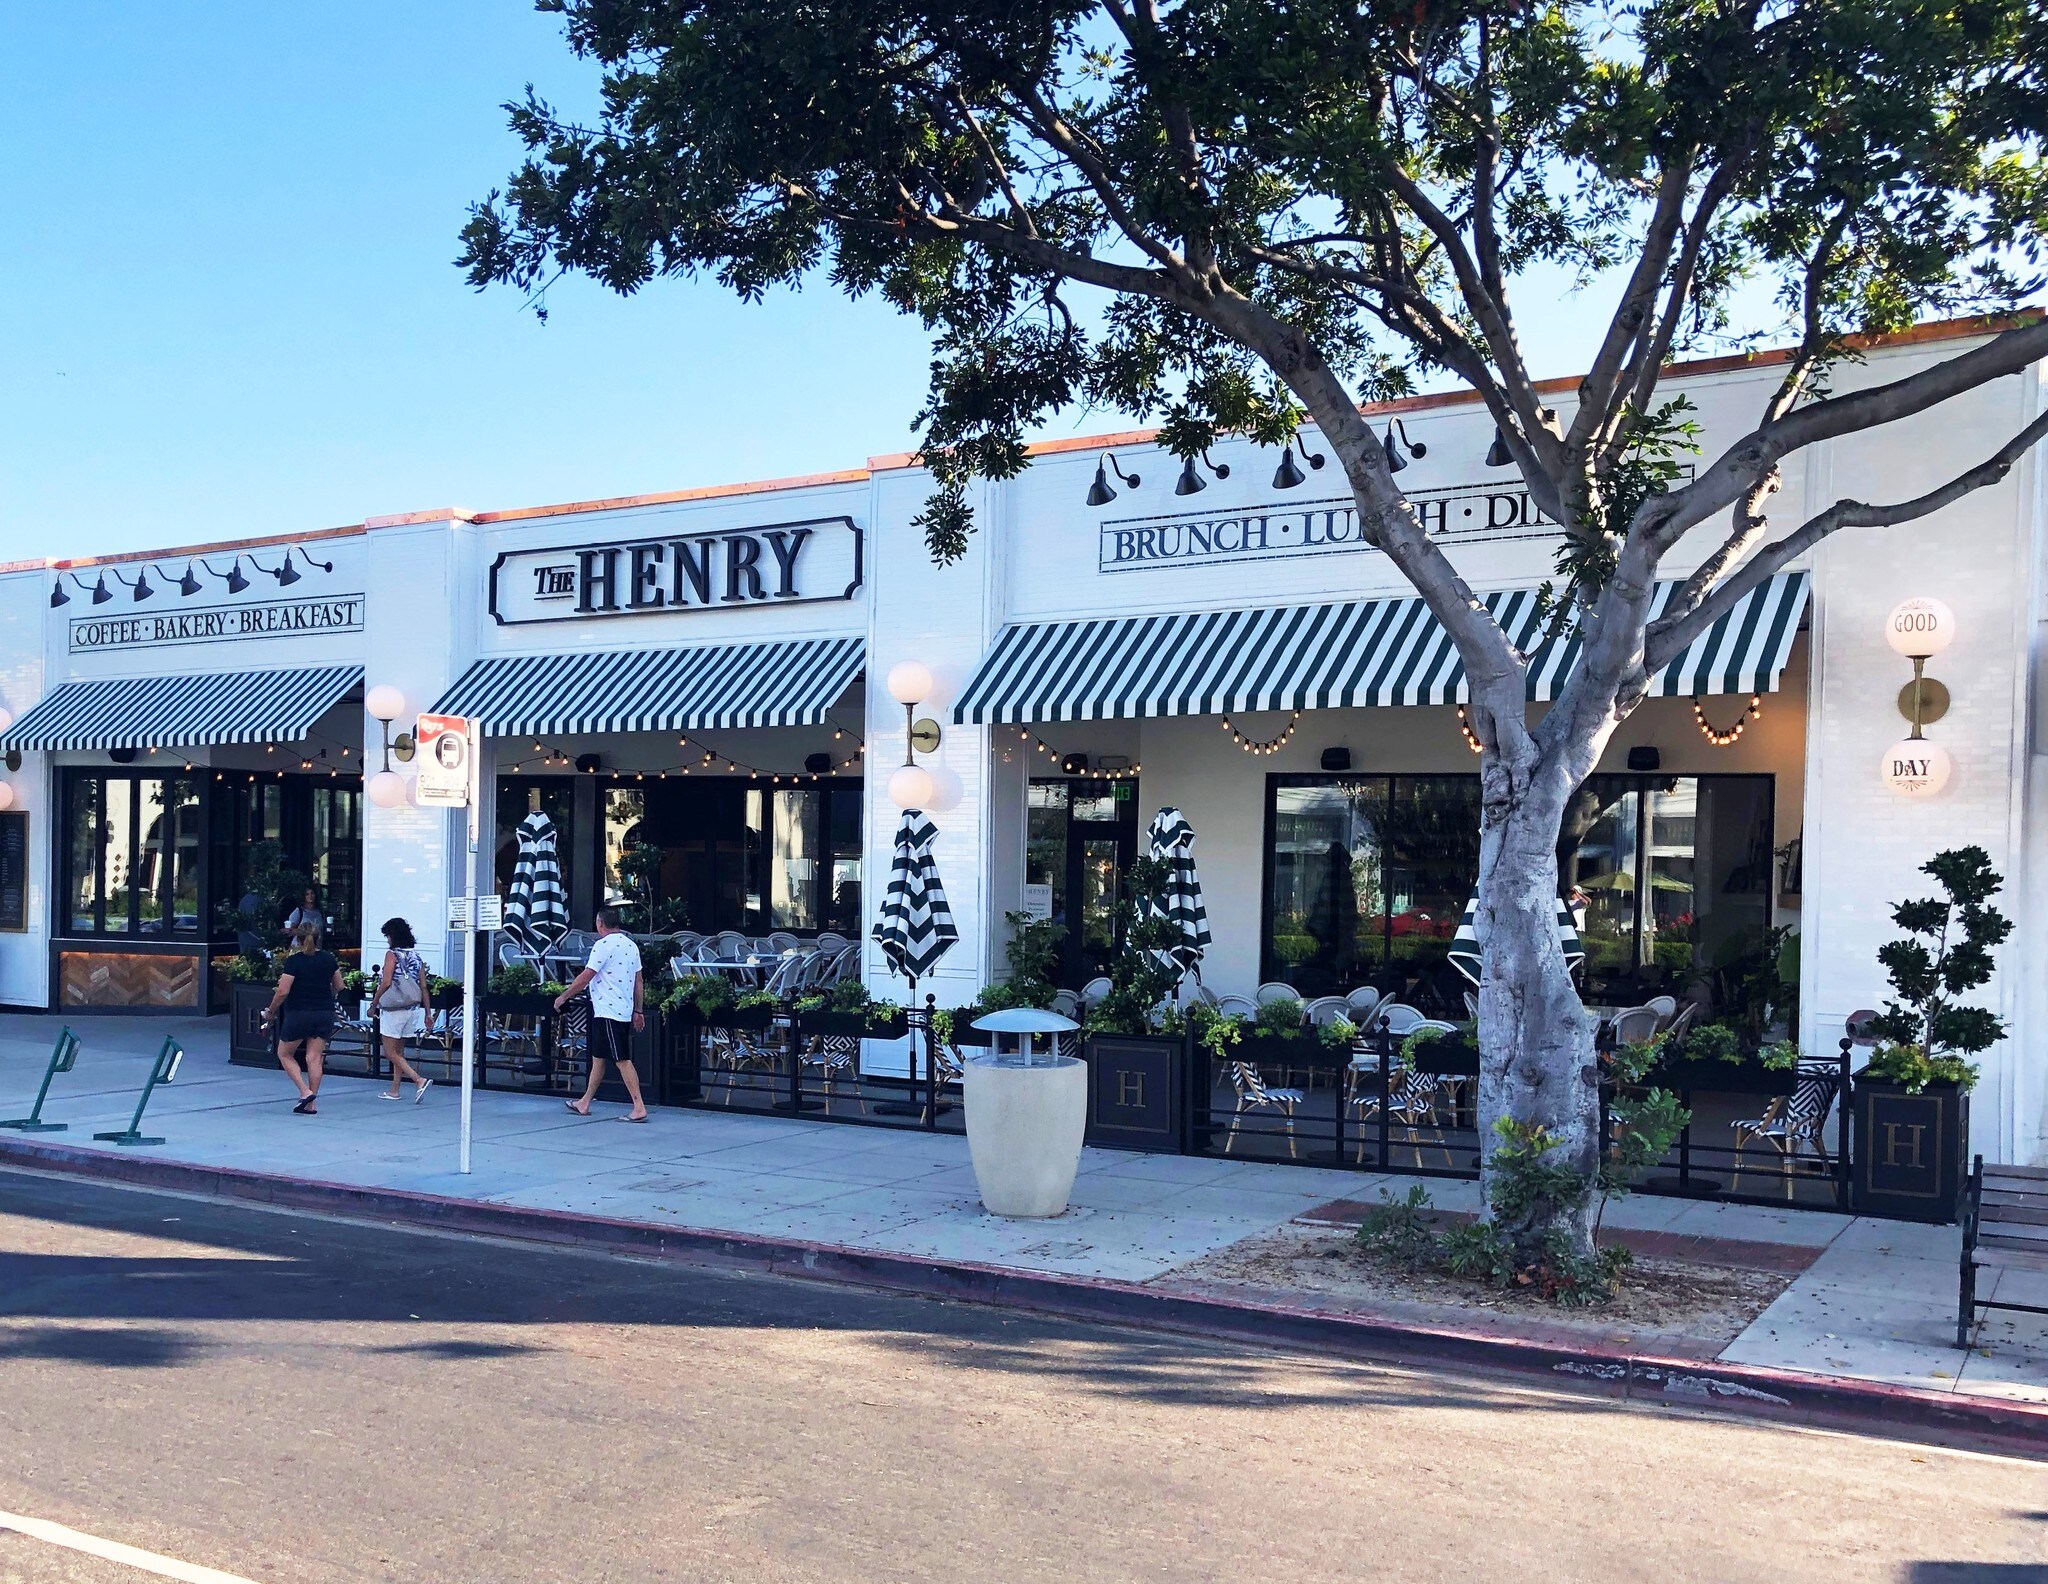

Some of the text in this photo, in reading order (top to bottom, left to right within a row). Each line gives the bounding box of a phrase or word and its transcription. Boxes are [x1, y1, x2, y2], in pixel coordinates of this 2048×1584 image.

[1114, 517, 1269, 561] BRUNCH
[1301, 501, 1449, 545] LUH
[534, 528, 812, 613] THE HENRY
[76, 603, 357, 645] COFFEE BAKERY BREAKFAST
[1894, 613, 1938, 633] GOOD
[1893, 759, 1932, 777] DAY
[1116, 1069, 1147, 1108] H
[1882, 1122, 1926, 1168] H
